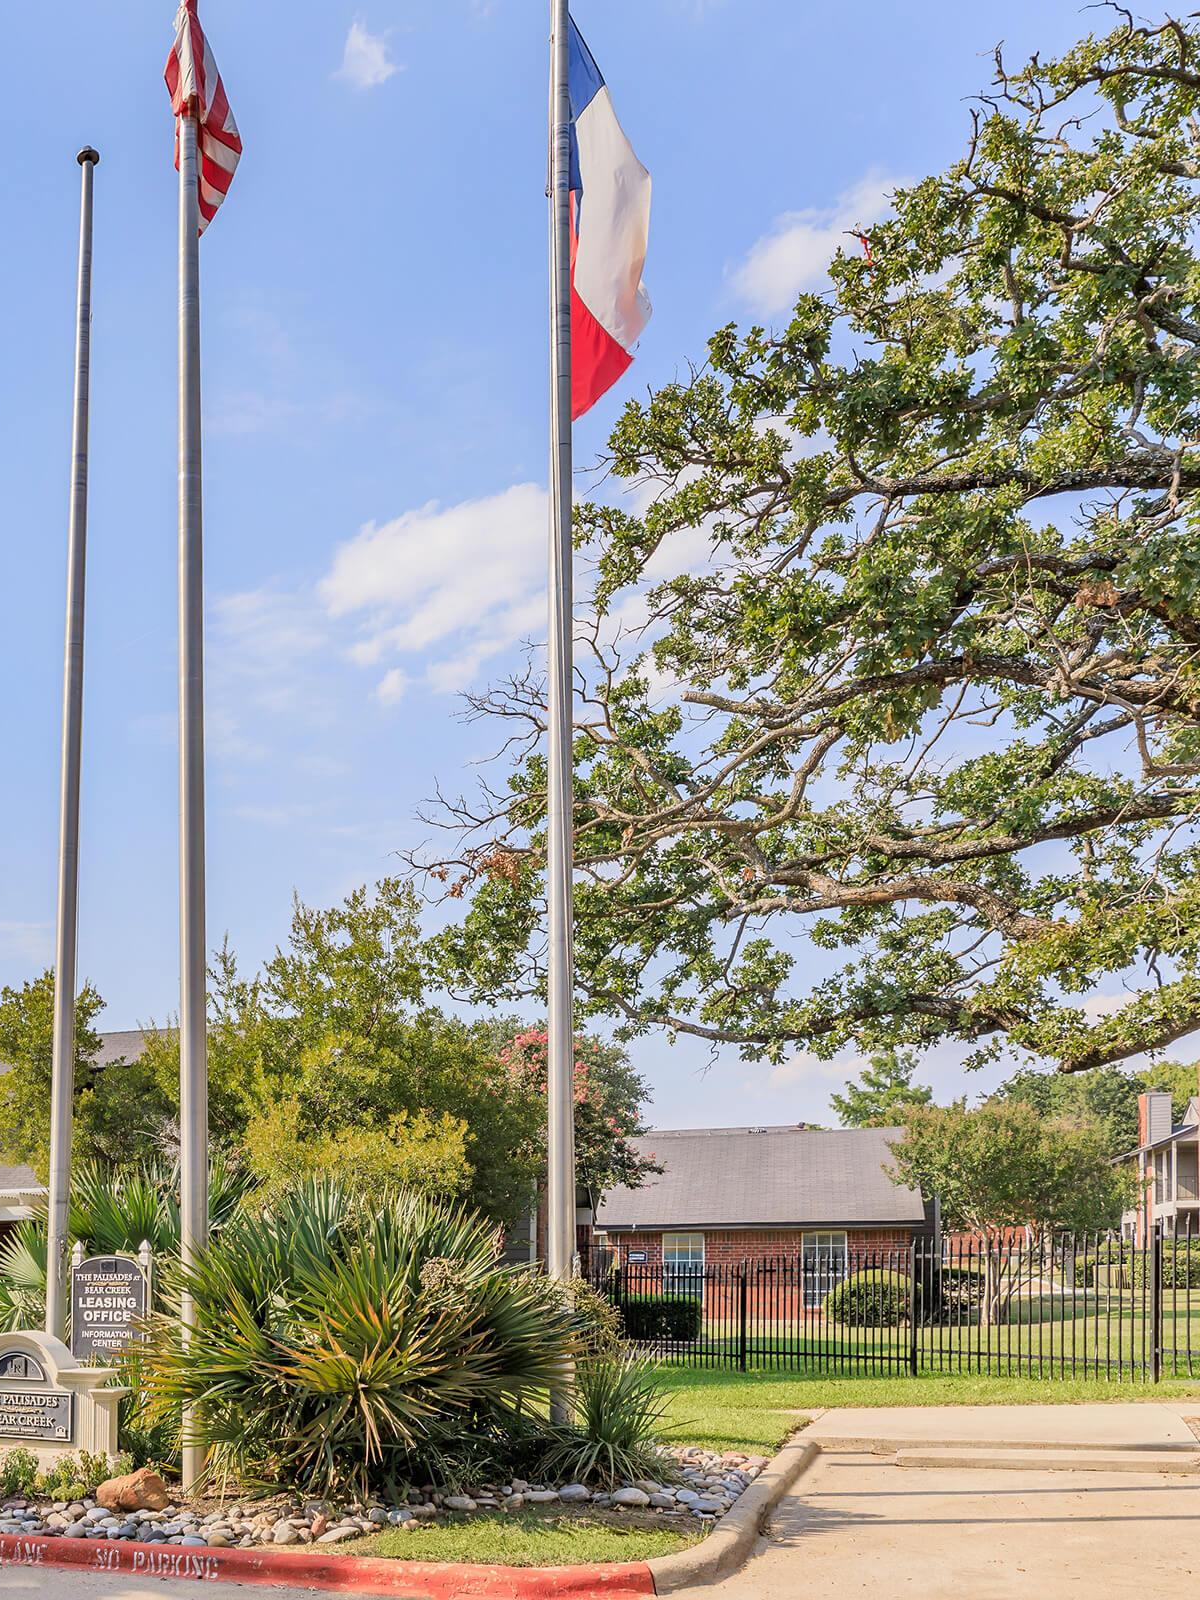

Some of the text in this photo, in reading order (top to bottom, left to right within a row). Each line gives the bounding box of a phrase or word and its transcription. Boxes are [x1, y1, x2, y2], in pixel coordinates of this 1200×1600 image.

[75, 1273, 92, 1281] THE
[93, 1273, 133, 1281] PALISADES
[84, 1286, 131, 1295] BEAR CREEK
[78, 1297, 137, 1308] LEASING
[83, 1310, 132, 1322] OFFICE
[81, 1330, 133, 1339] INFORMATION
[91, 1340, 122, 1348] CENTER
[3, 1394, 59, 1408] PALISADES
[18, 1416, 55, 1428] CREEK
[93, 1548, 218, 1578] NO PARKING
